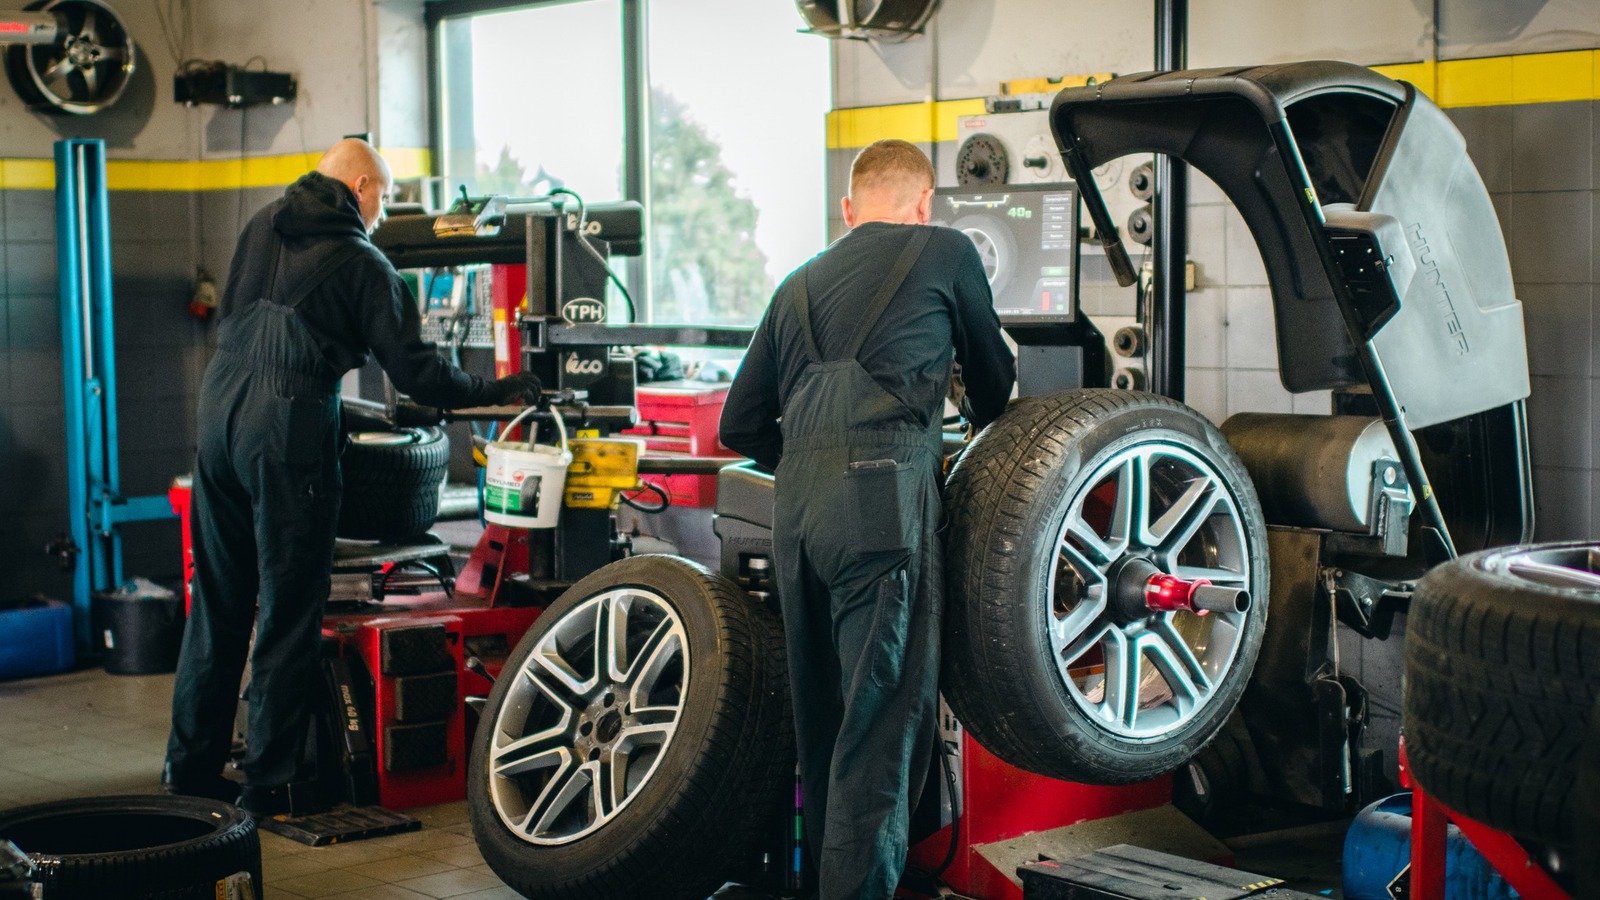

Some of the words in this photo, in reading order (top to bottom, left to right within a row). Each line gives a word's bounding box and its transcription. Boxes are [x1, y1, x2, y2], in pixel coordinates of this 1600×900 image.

[1406, 222, 1469, 355] HUNTER
[569, 304, 600, 319] TPH
[348, 719, 359, 731] kg
